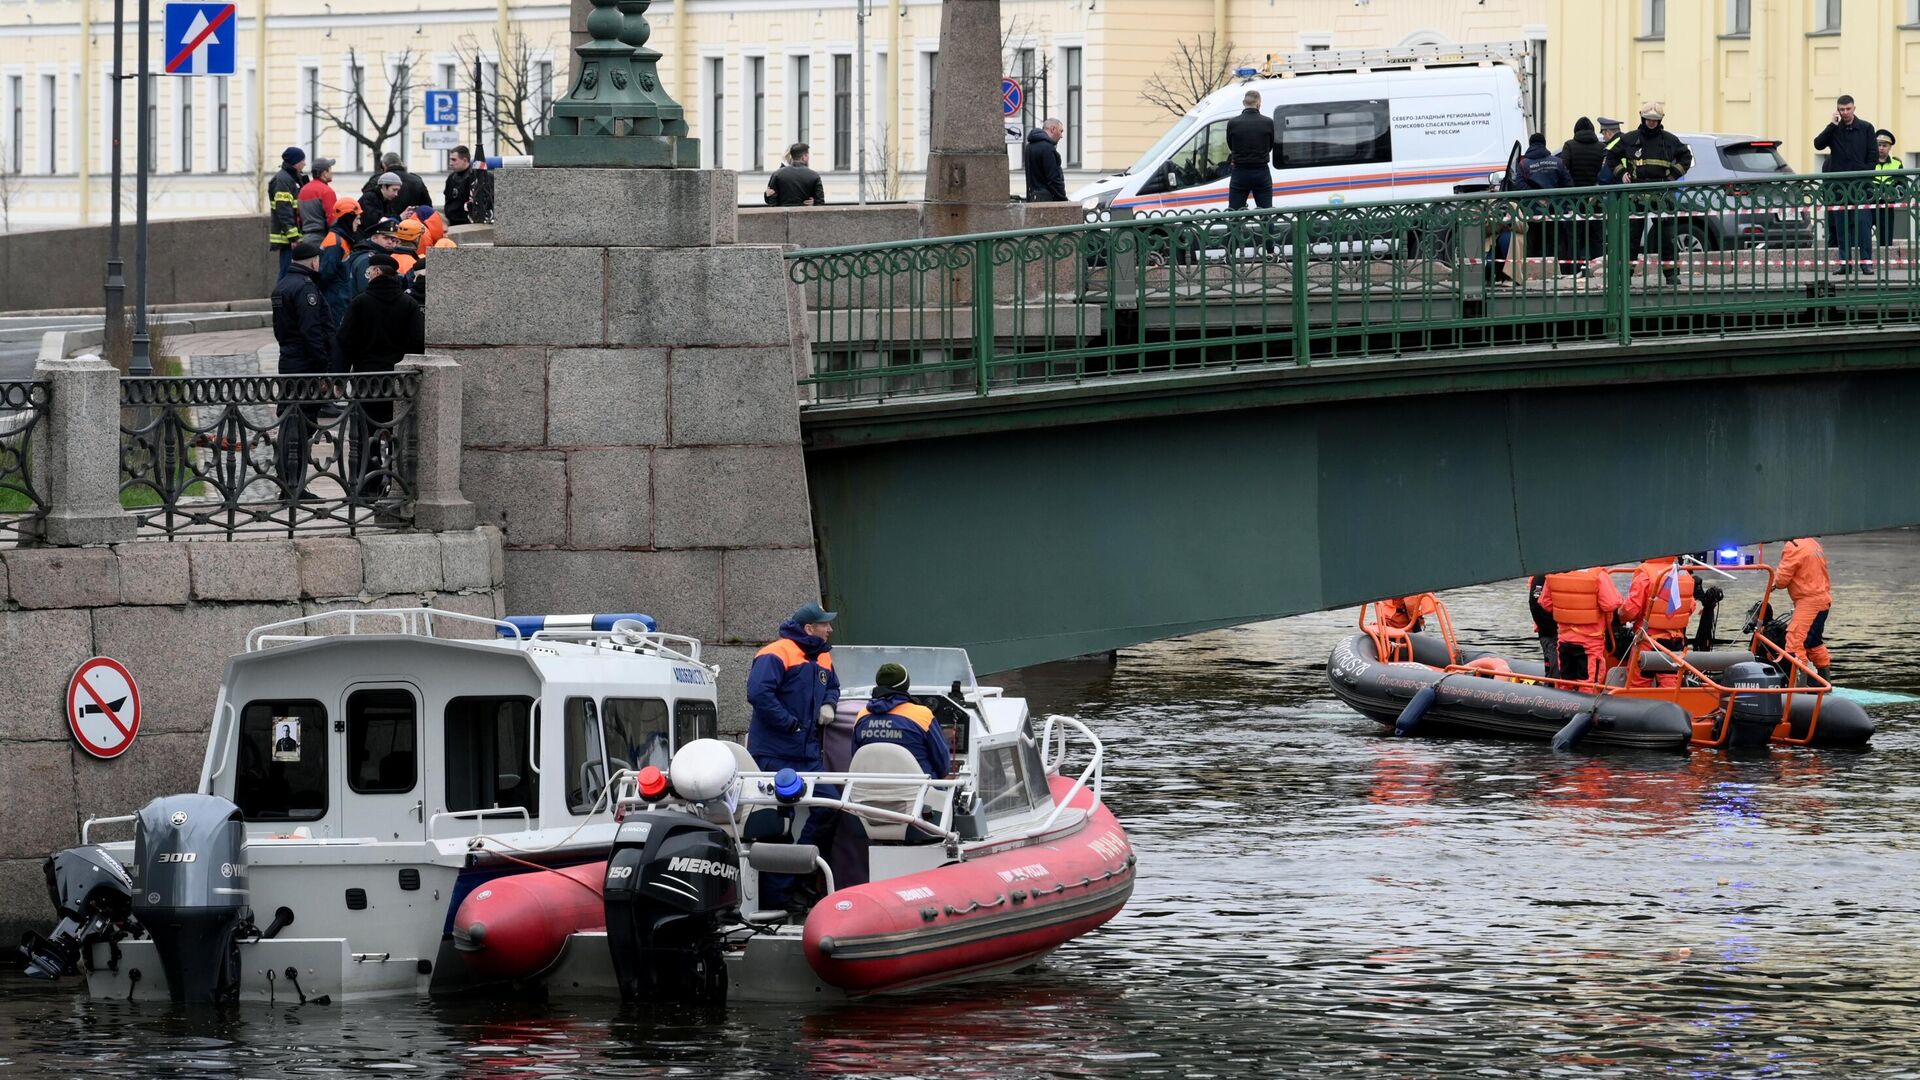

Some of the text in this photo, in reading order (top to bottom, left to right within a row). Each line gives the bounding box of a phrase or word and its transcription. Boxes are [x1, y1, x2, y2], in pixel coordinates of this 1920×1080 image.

[1392, 111, 1491, 122] СЕВЕРО-ЗАПАДНЫЙ РЕГИОНАЛЬНЫЙ
[1395, 121, 1470, 129] ПОИСКОВО-СПАСАТЕЛЬНЫЙ
[869, 720, 893, 729] МЧС
[861, 730, 903, 739] РОССИИ
[158, 853, 197, 863] 300
[608, 866, 633, 879] 150
[667, 856, 740, 881] MERCURY
